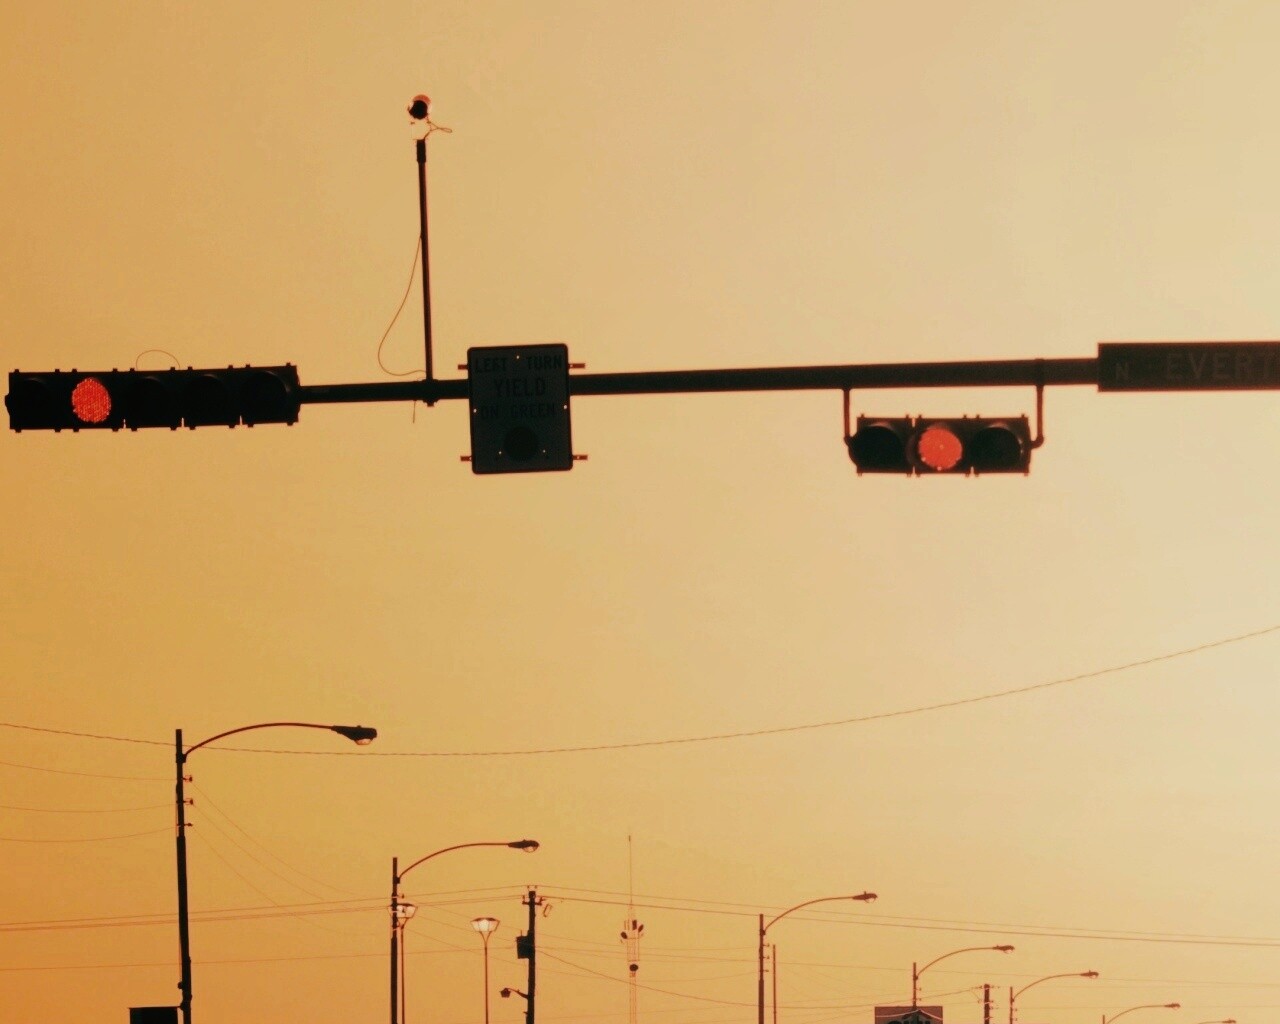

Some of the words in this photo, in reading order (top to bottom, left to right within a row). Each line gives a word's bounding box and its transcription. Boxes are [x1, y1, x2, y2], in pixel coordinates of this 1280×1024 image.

[474, 356, 508, 374] LEFT
[526, 355, 562, 371] TURN
[1114, 362, 1130, 381] N
[493, 376, 547, 398] YIELD
[480, 404, 500, 420] ON
[510, 403, 557, 419] GREEN
